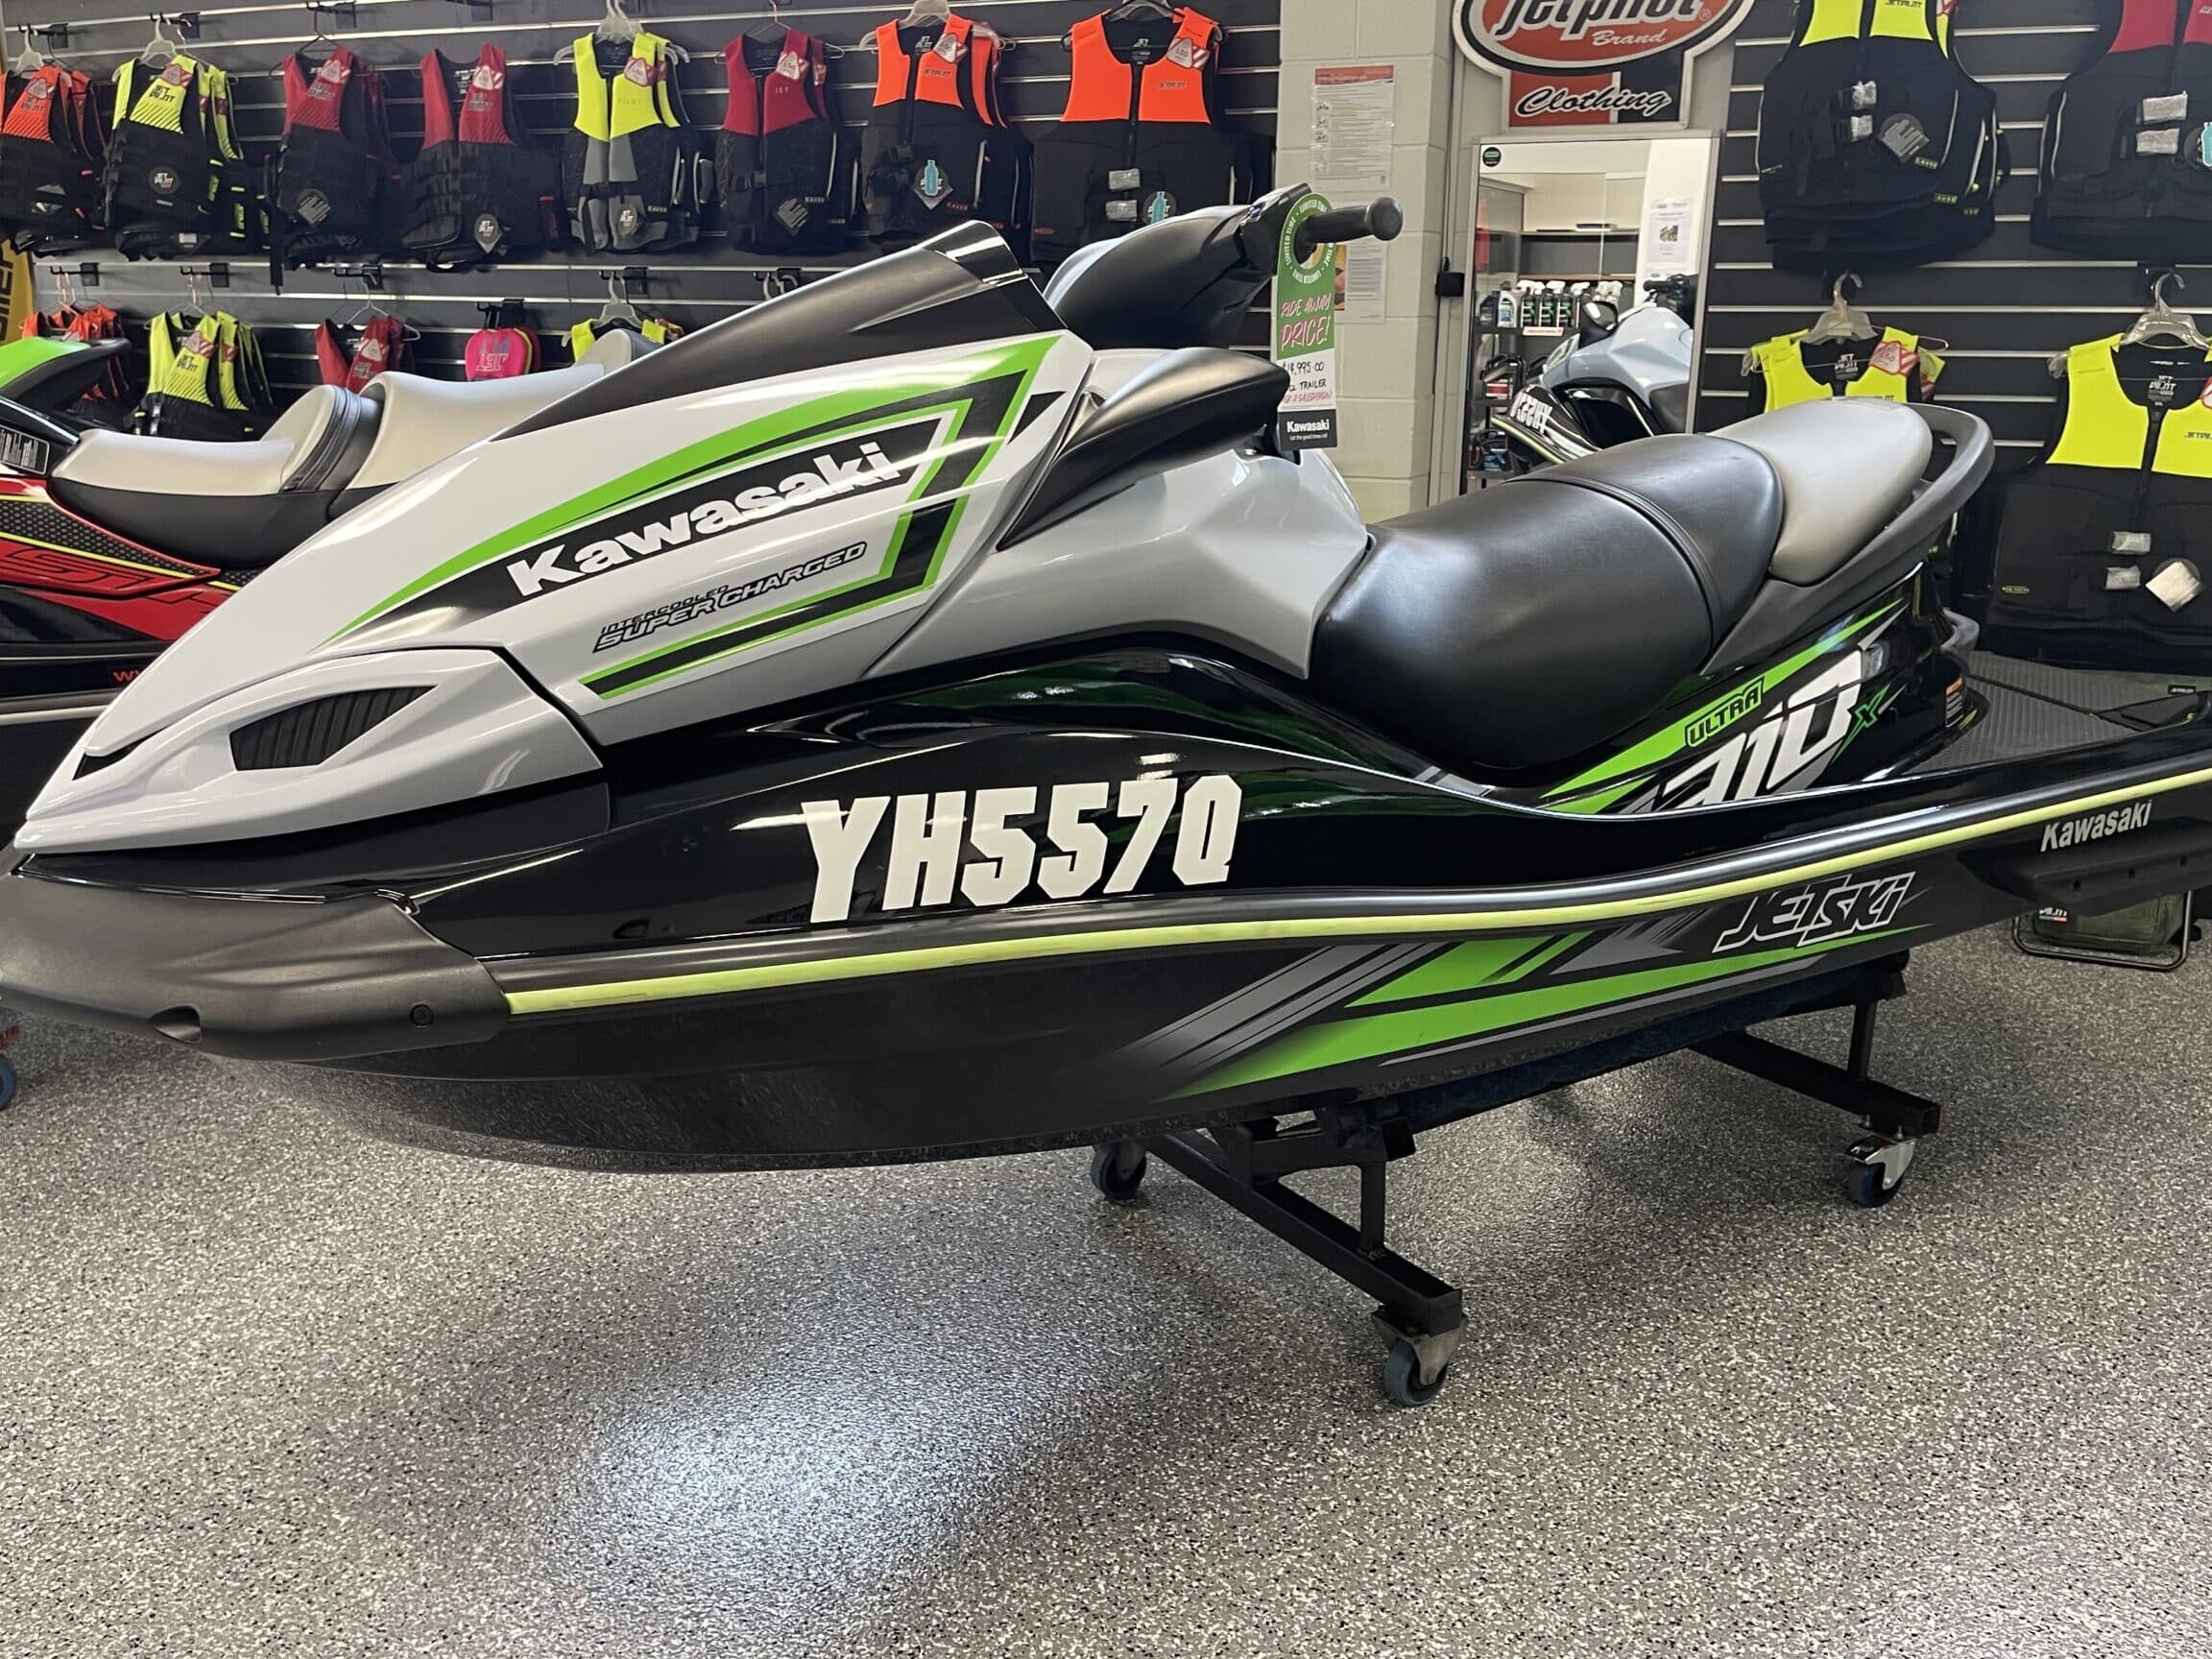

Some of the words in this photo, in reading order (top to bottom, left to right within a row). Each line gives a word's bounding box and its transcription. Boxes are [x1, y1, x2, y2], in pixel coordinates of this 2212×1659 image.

[1591, 29, 1668, 46] Brand
[1515, 84, 1672, 117] Clothing
[1281, 299, 1303, 318] RIDE
[1304, 293, 1331, 314] AWAY
[1281, 315, 1331, 351] PRICE!
[1299, 378, 1327, 390] TRAILER
[1286, 419, 1330, 433] Kawasaki
[507, 442, 902, 596] Kawasaki
[601, 584, 730, 635] INTERCOOLED
[1687, 683, 1763, 746] ULTRA
[2039, 799, 2153, 854] Kawasaki
[801, 775, 1242, 924] YH557Q
